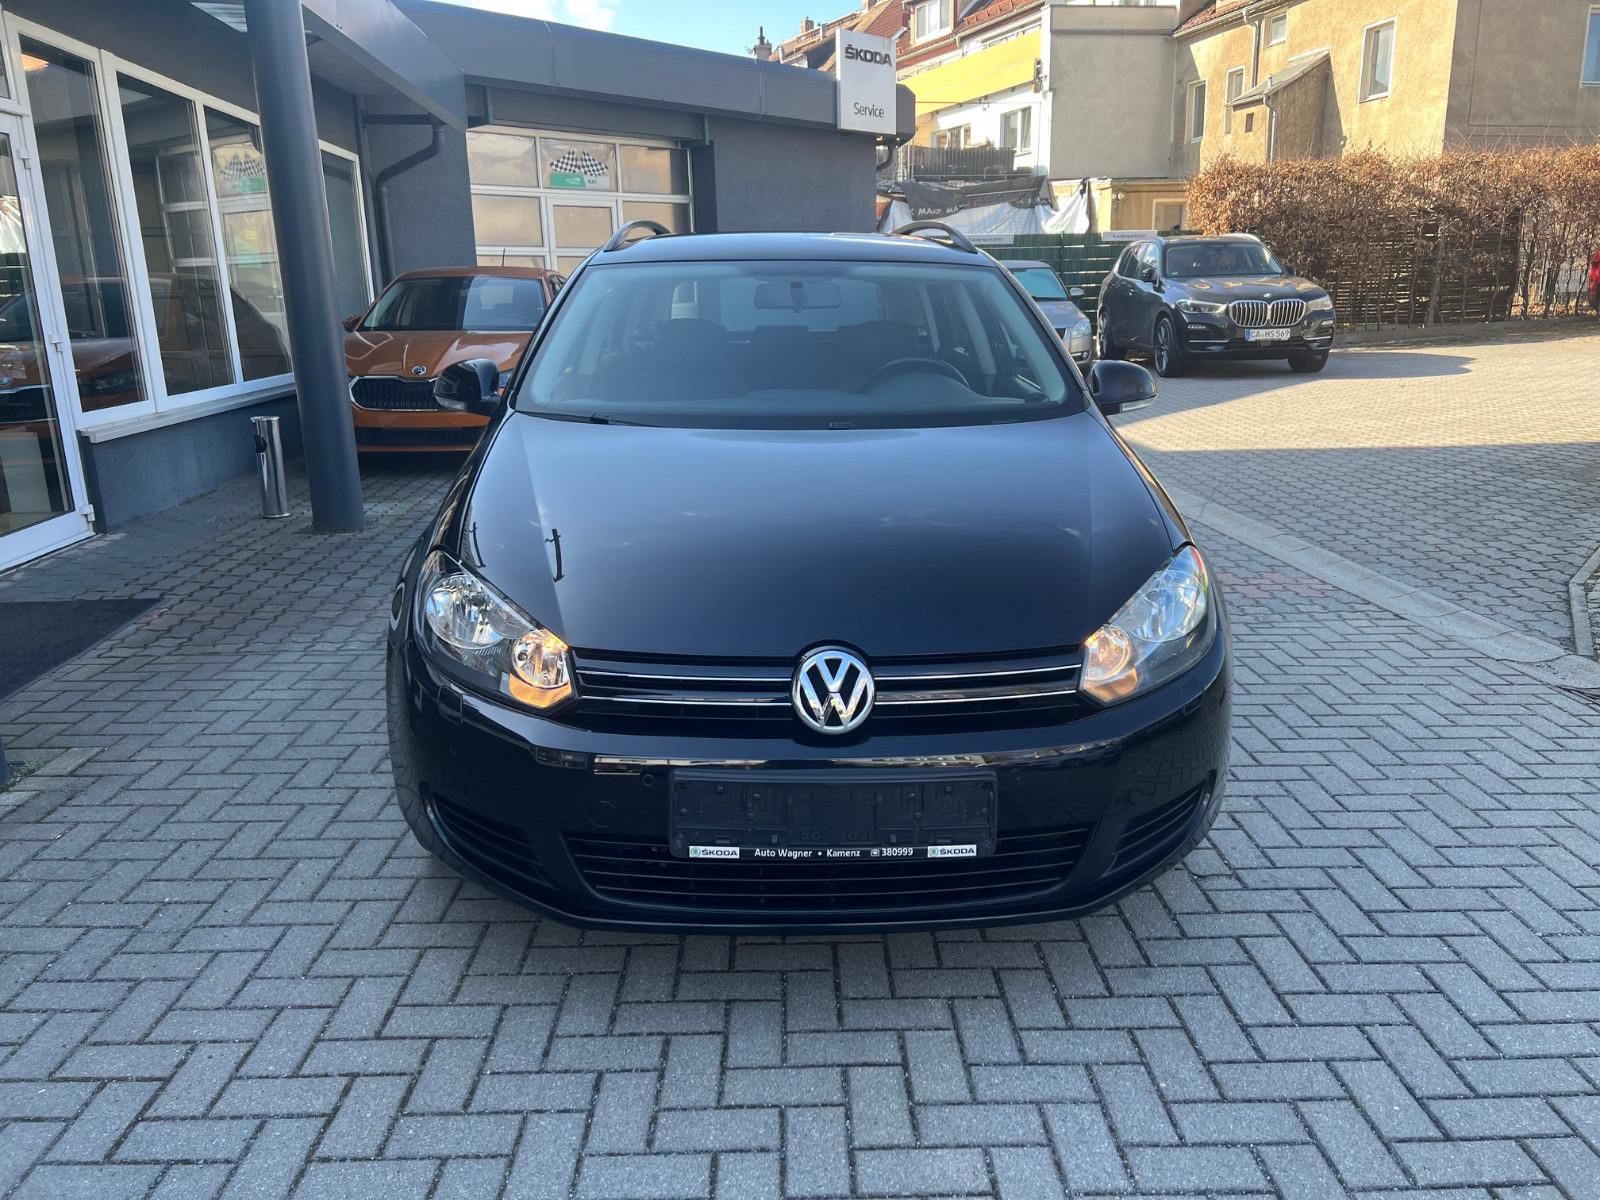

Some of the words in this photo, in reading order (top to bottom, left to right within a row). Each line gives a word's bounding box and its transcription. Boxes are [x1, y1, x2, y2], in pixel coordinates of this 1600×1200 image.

[845, 44, 892, 67] ŠKODA
[854, 102, 884, 118] Service
[701, 849, 738, 857] ŠKODA
[754, 848, 776, 858] Auto
[778, 849, 813, 860] Wagner
[826, 848, 861, 858] Kamenz
[881, 847, 914, 857] 380999
[939, 846, 975, 856] ŠKODA
